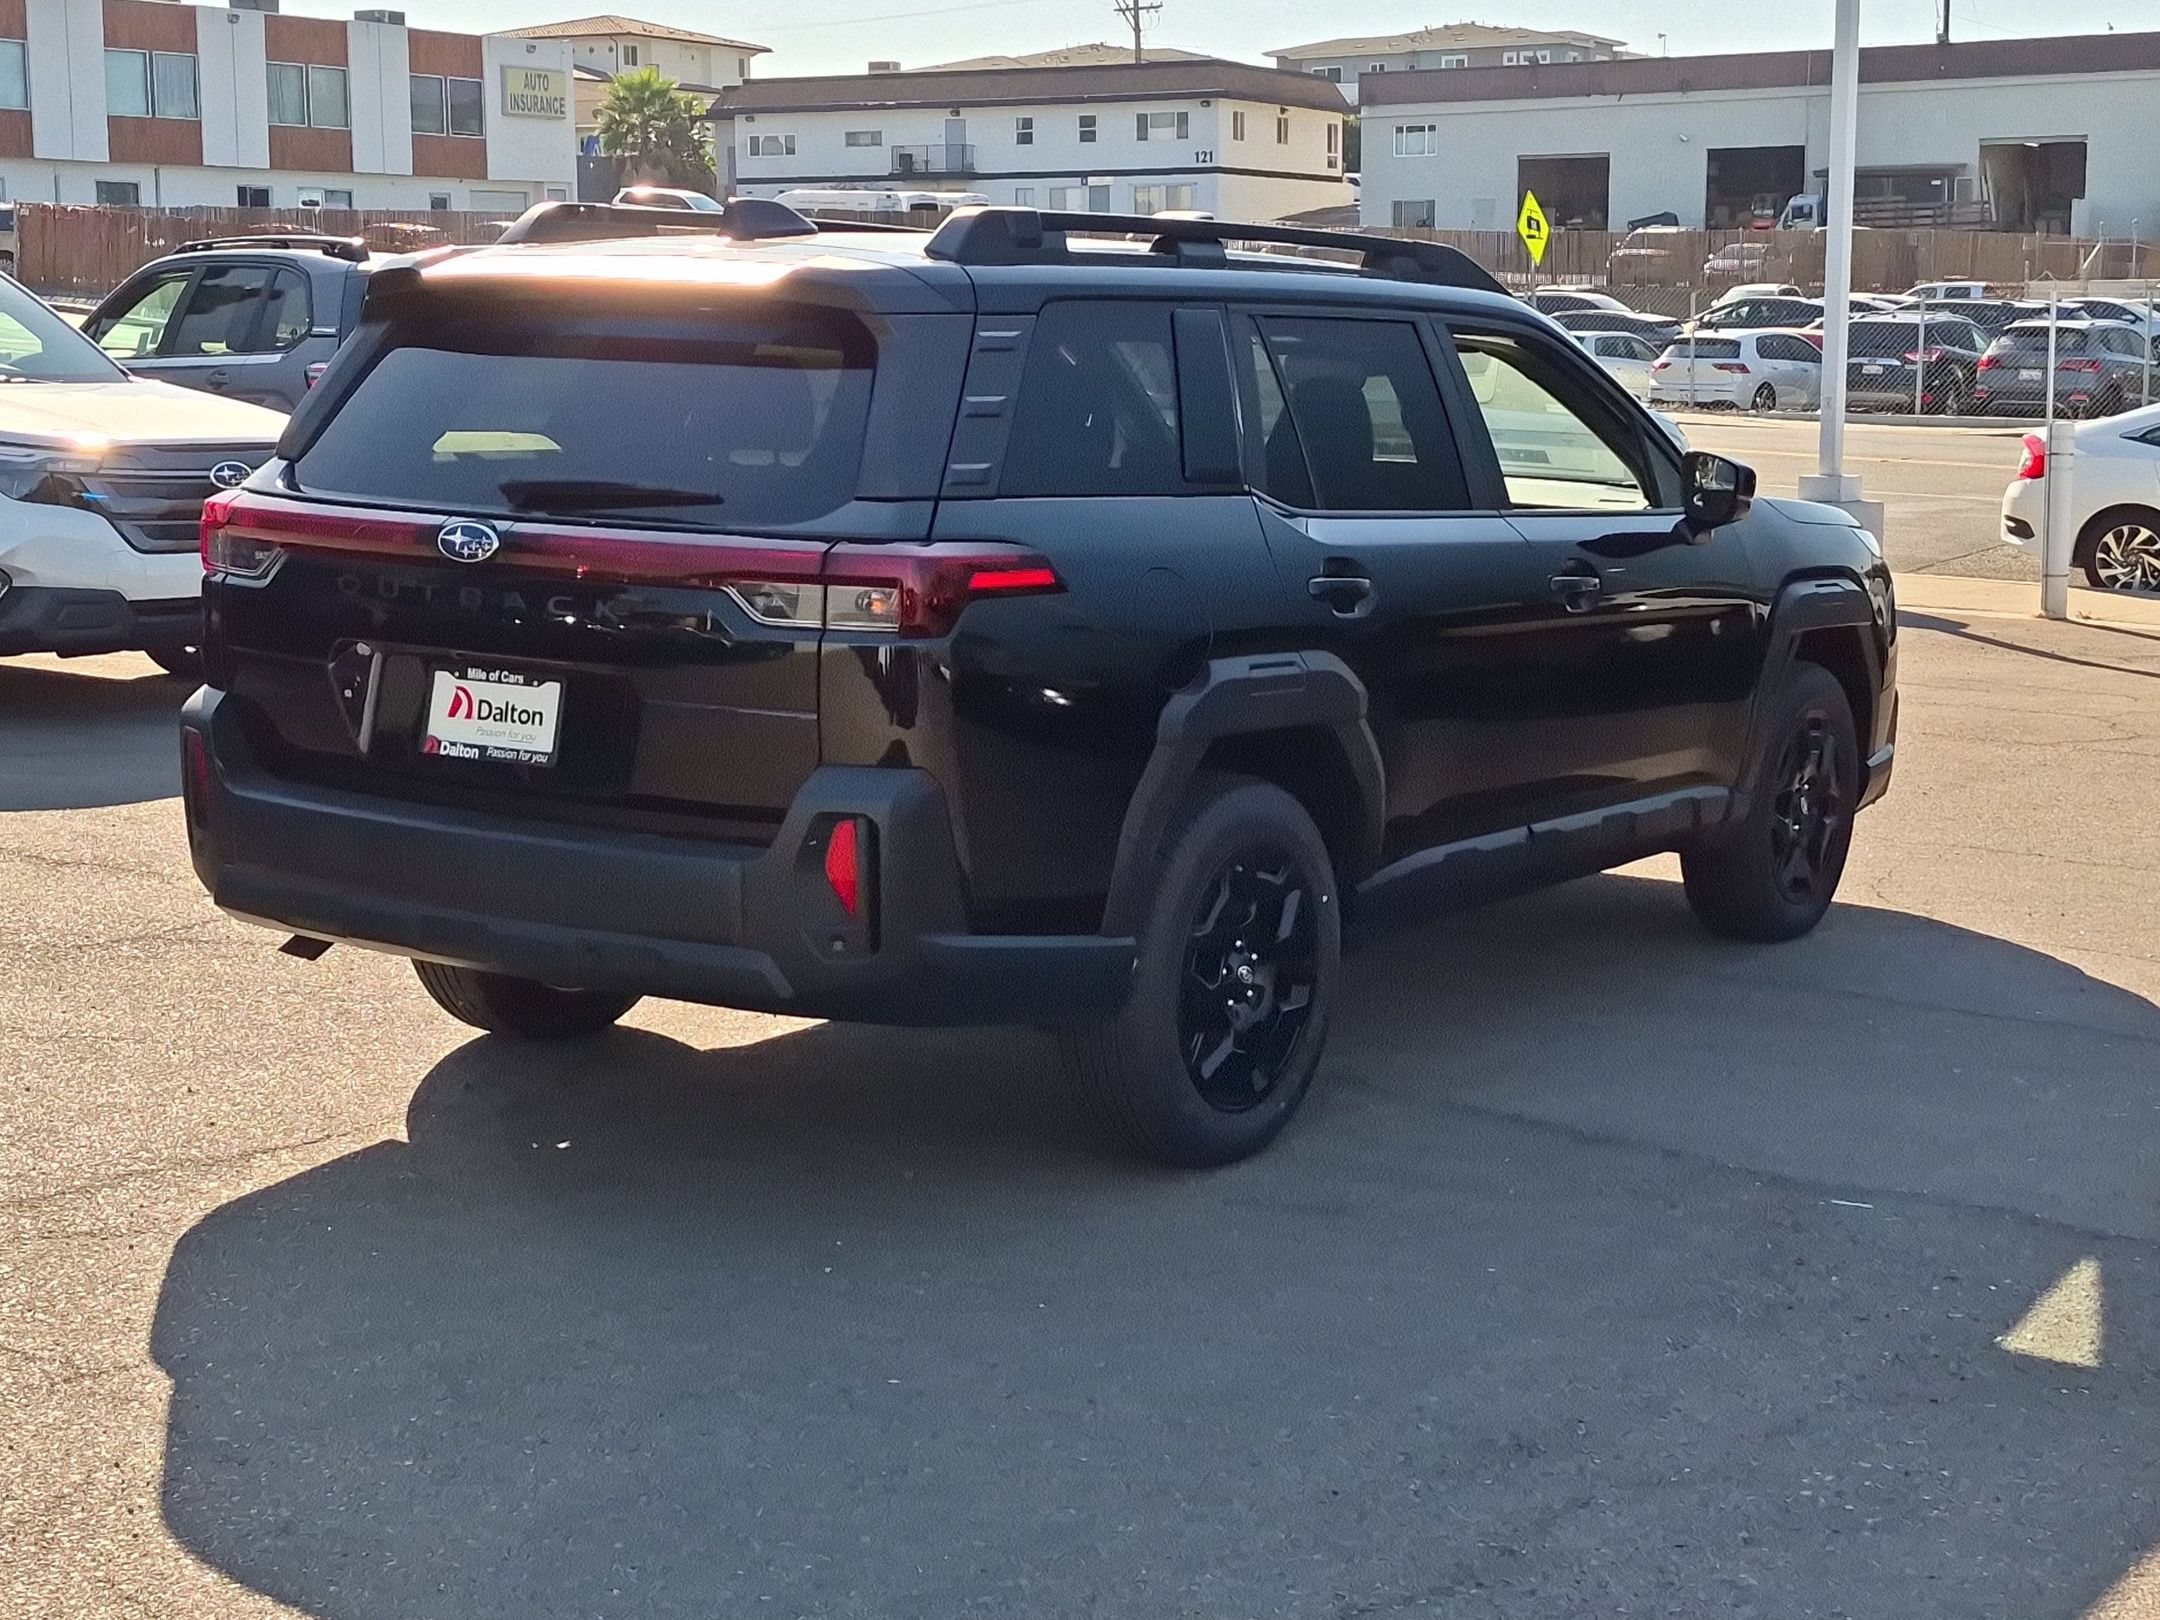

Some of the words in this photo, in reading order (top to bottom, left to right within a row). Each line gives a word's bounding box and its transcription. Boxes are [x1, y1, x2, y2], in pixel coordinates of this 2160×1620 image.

[524, 72, 549, 91] AUTO
[509, 92, 565, 115] INSURANCE
[1194, 150, 1213, 163] 121
[337, 574, 626, 620] OUTBACK
[467, 667, 486, 680] Mile
[488, 670, 499, 681] of
[501, 670, 524, 684] Cars
[477, 699, 543, 726] Dalton
[475, 726, 506, 738] Passion
[507, 729, 521, 740] for
[521, 733, 537, 741] you
[440, 741, 479, 759] Dalton
[486, 746, 517, 760] Passion
[517, 750, 532, 760] for
[531, 753, 549, 763] you
